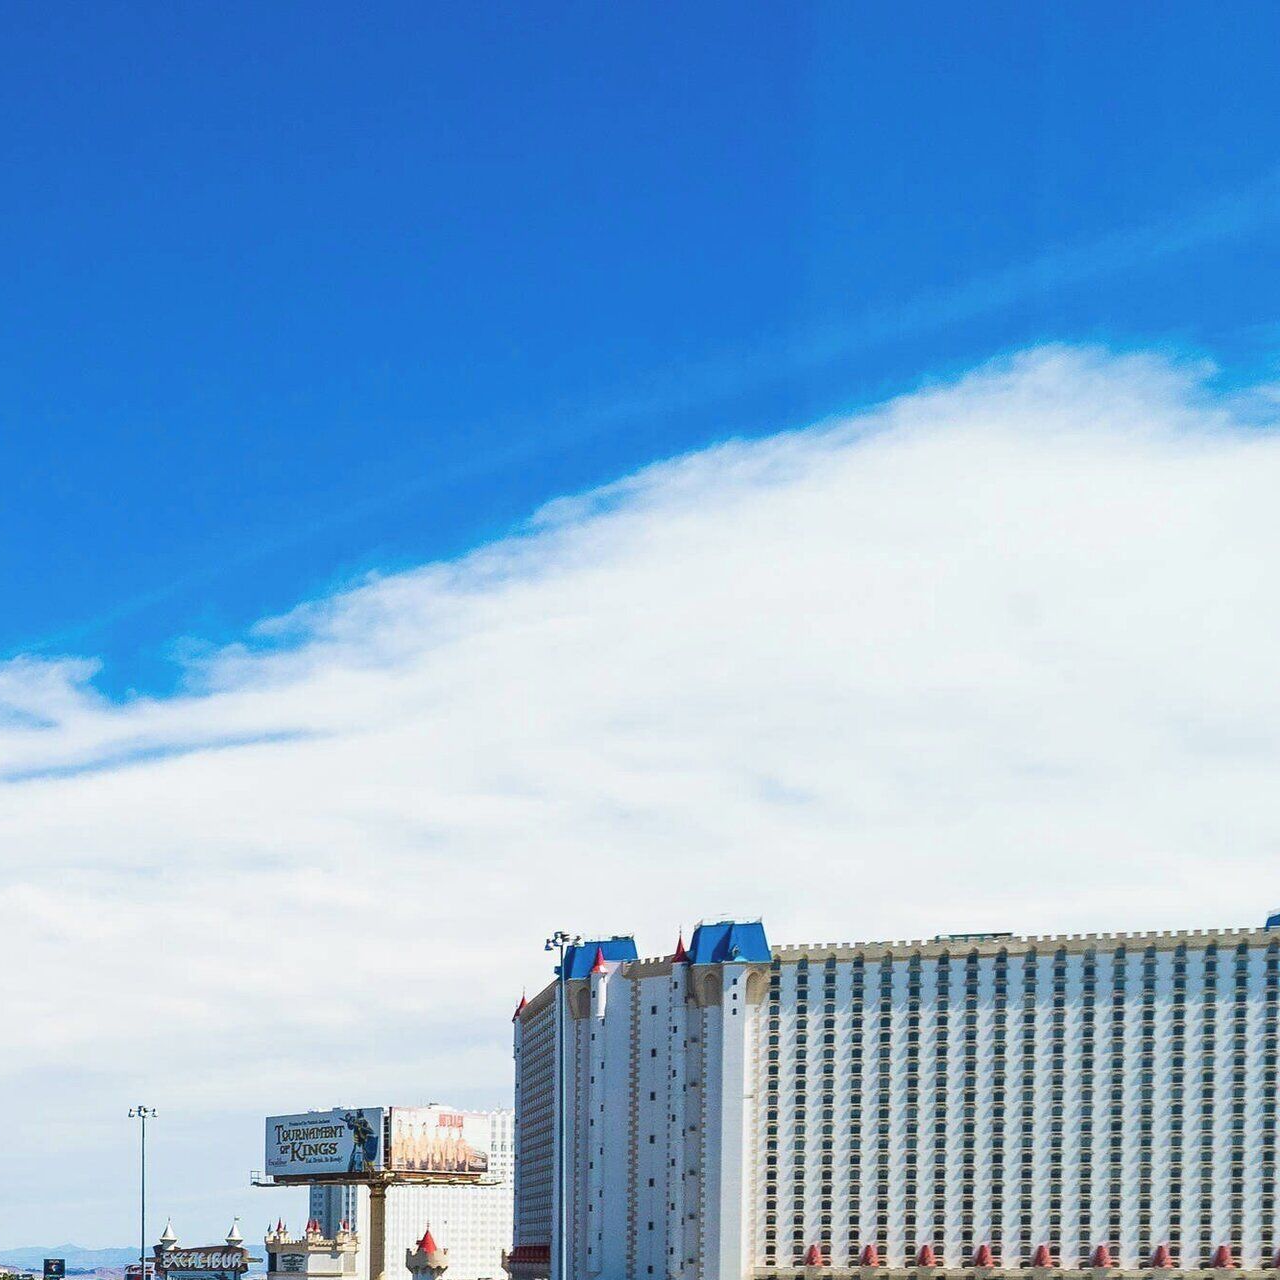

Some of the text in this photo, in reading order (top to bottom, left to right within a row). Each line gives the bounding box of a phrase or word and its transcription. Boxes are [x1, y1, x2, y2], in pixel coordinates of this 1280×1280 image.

[274, 1124, 345, 1145] TOURNAMENT
[289, 1141, 338, 1162] KINGS
[161, 1252, 241, 1269] EXCALIBUR
